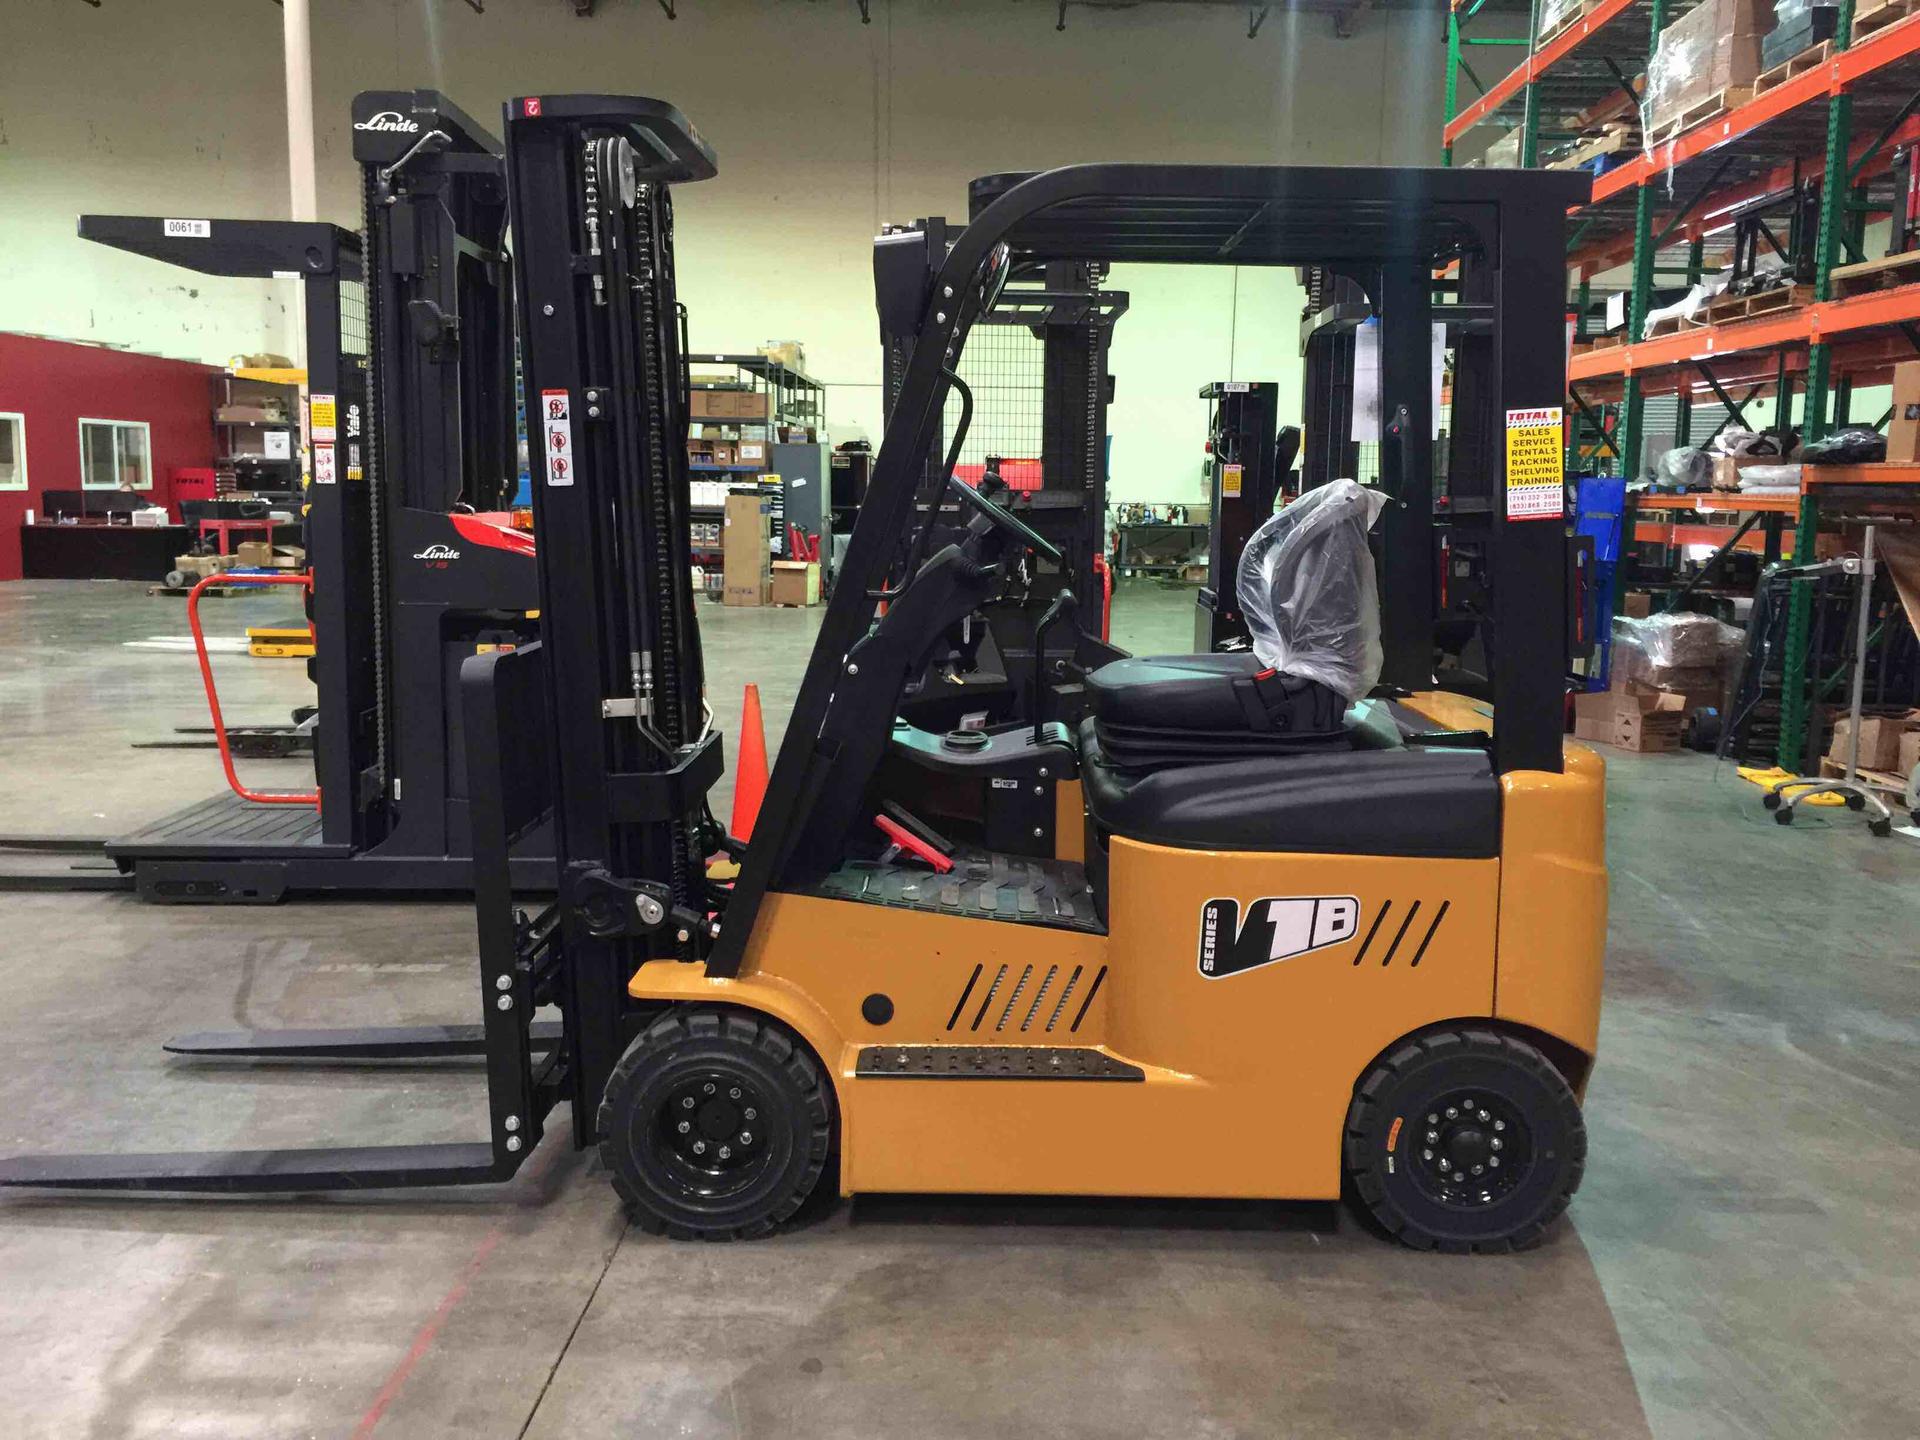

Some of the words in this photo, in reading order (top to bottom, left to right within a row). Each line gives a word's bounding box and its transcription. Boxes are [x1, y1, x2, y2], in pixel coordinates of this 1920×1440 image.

[354, 111, 419, 133] Linde
[169, 221, 192, 233] 0061
[1509, 411, 1548, 421] TOTAL
[1518, 428, 1551, 437] SALES
[1513, 437, 1557, 447] SERVICE
[1511, 447, 1558, 457] RENTALS
[1511, 456, 1558, 467] RACKING
[1510, 466, 1560, 477] SHELVING
[1510, 476, 1560, 486] TRAINING
[413, 544, 461, 559] Linde
[1203, 906, 1218, 972] SERIES
